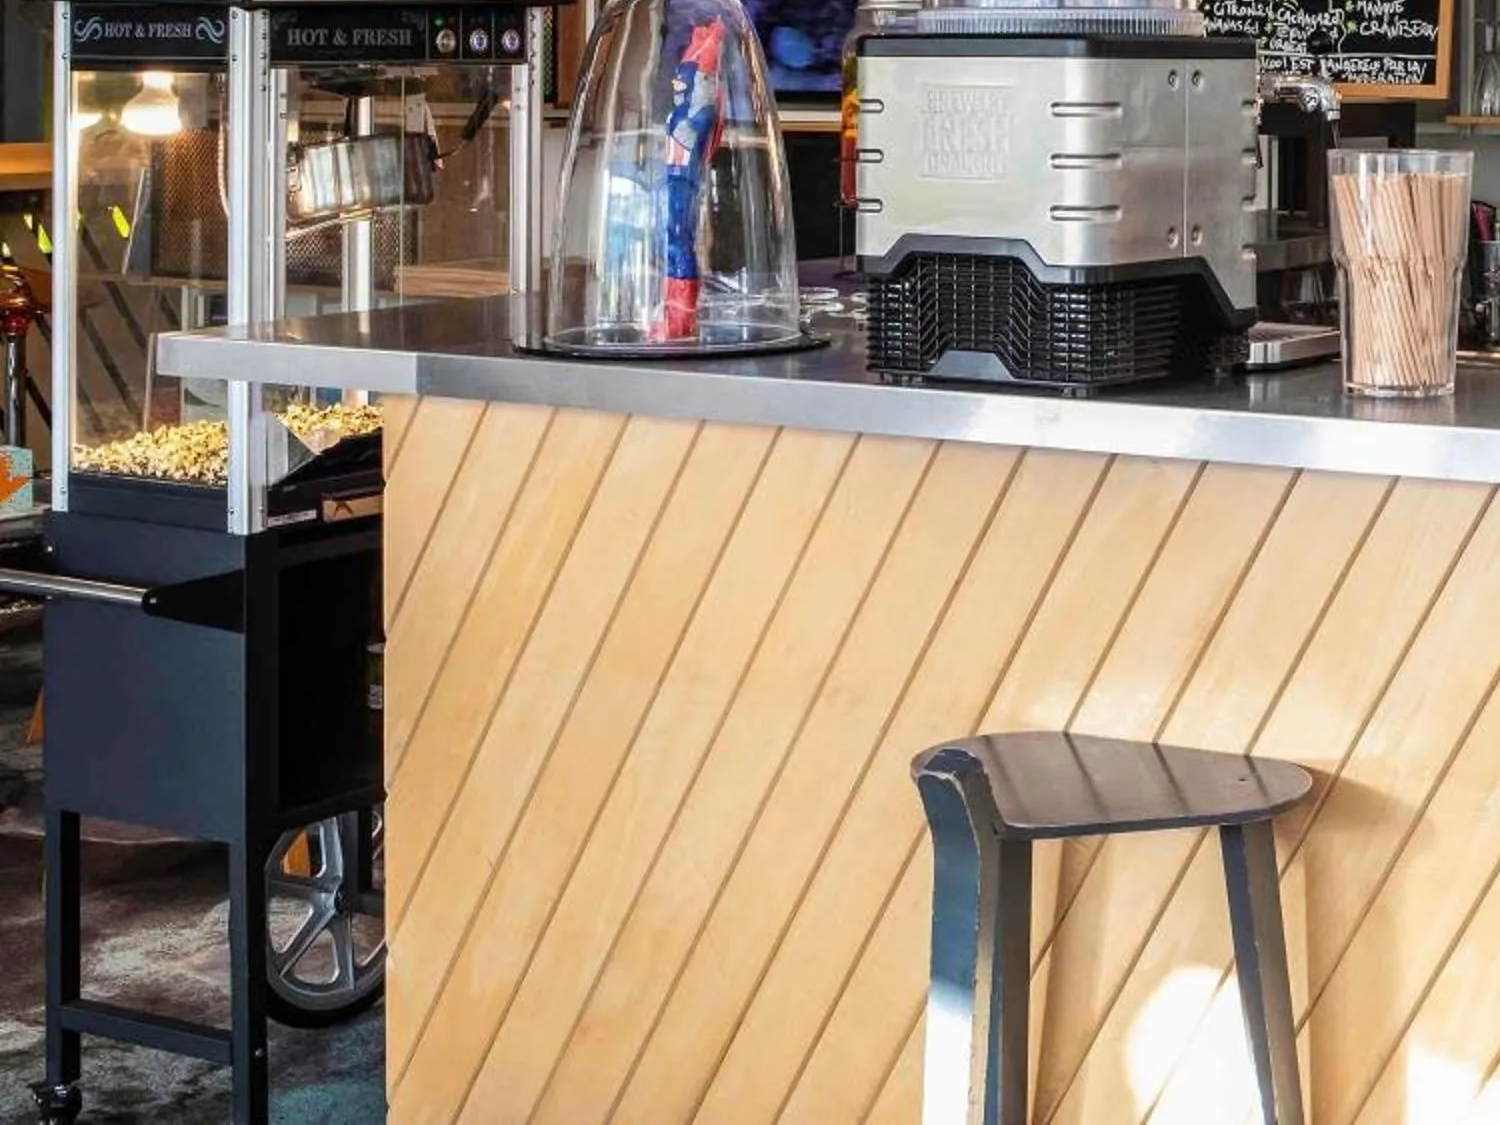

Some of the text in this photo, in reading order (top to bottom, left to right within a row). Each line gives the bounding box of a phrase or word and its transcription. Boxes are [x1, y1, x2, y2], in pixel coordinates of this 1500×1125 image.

[104, 21, 192, 39] HOT & FRESH
[287, 28, 413, 46] HOT & FRESH
